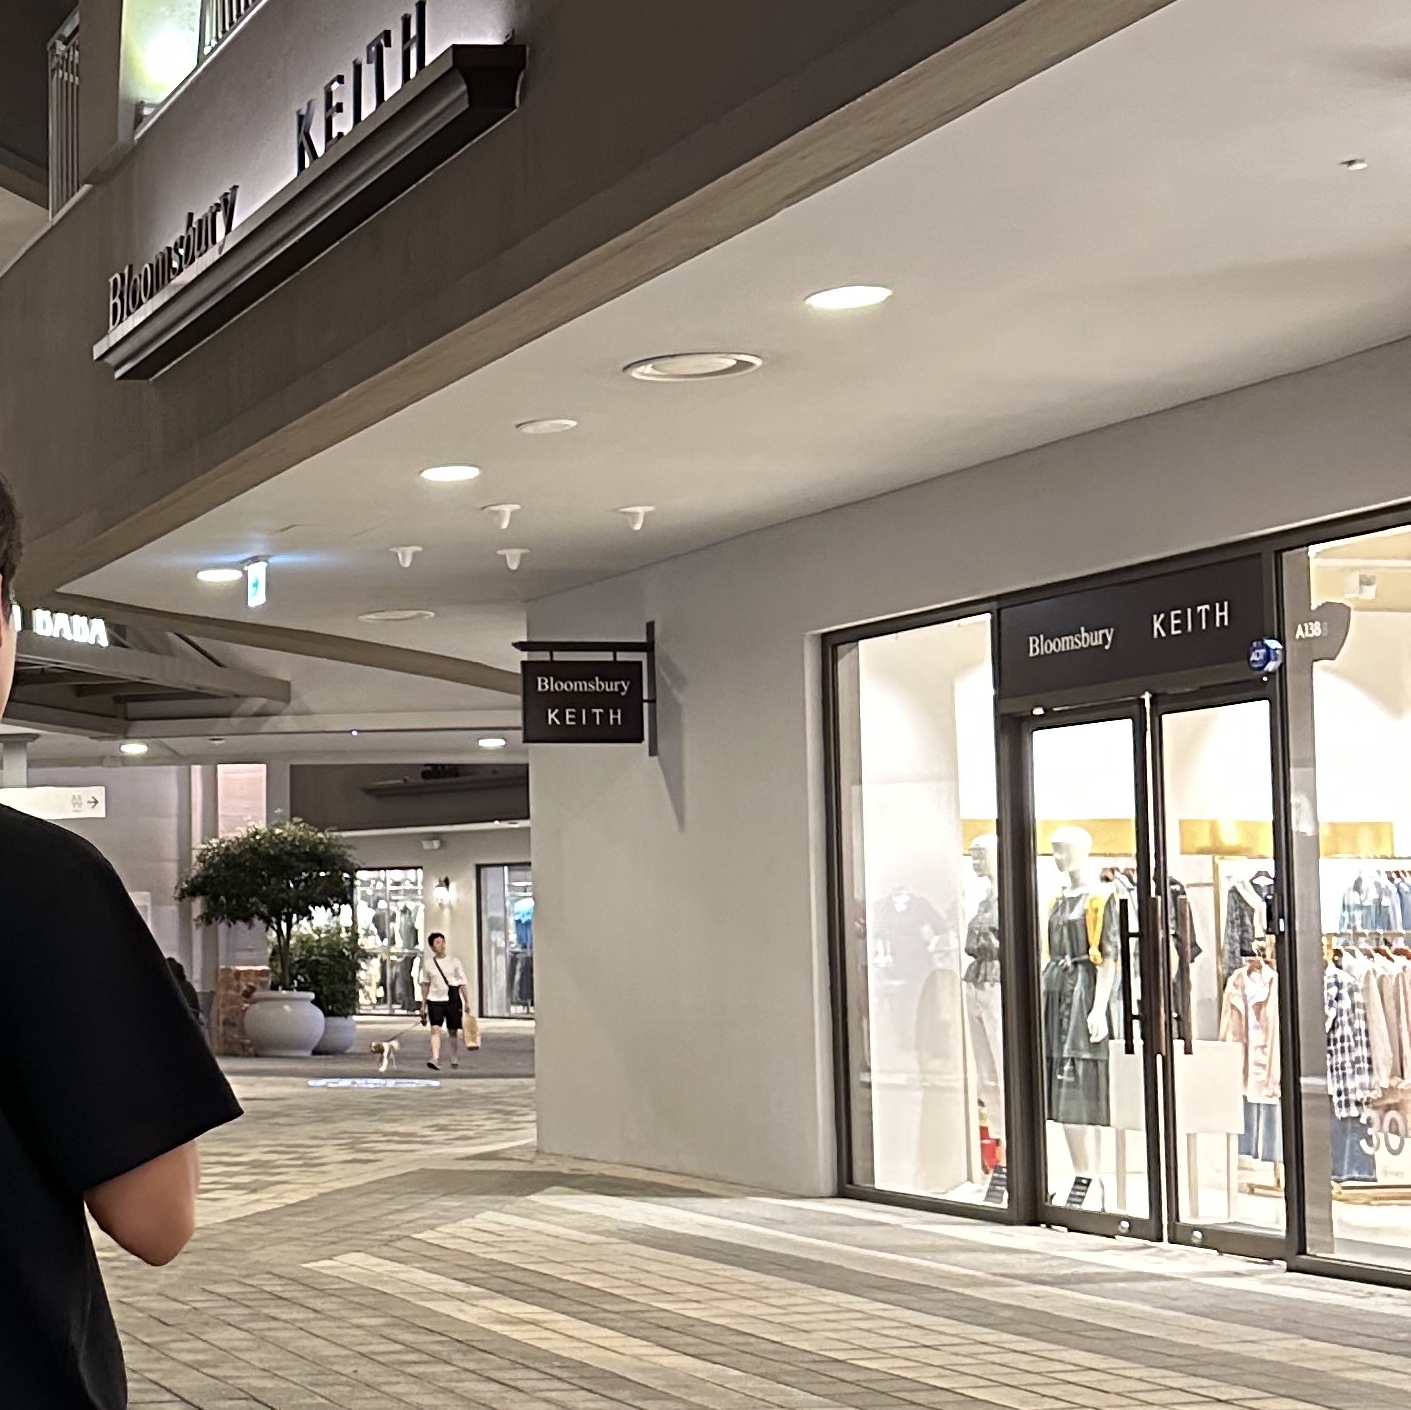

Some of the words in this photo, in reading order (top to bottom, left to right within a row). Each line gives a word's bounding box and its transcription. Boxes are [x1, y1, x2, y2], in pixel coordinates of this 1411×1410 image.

[108, 184, 240, 335] Bloomsbury
[296, 0, 427, 177] KEITH
[1028, 626, 1115, 658] Bloomsbury
[1152, 600, 1230, 639] KEITH
[536, 676, 630, 696] Bloomsbury
[547, 708, 622, 725] KEITH
